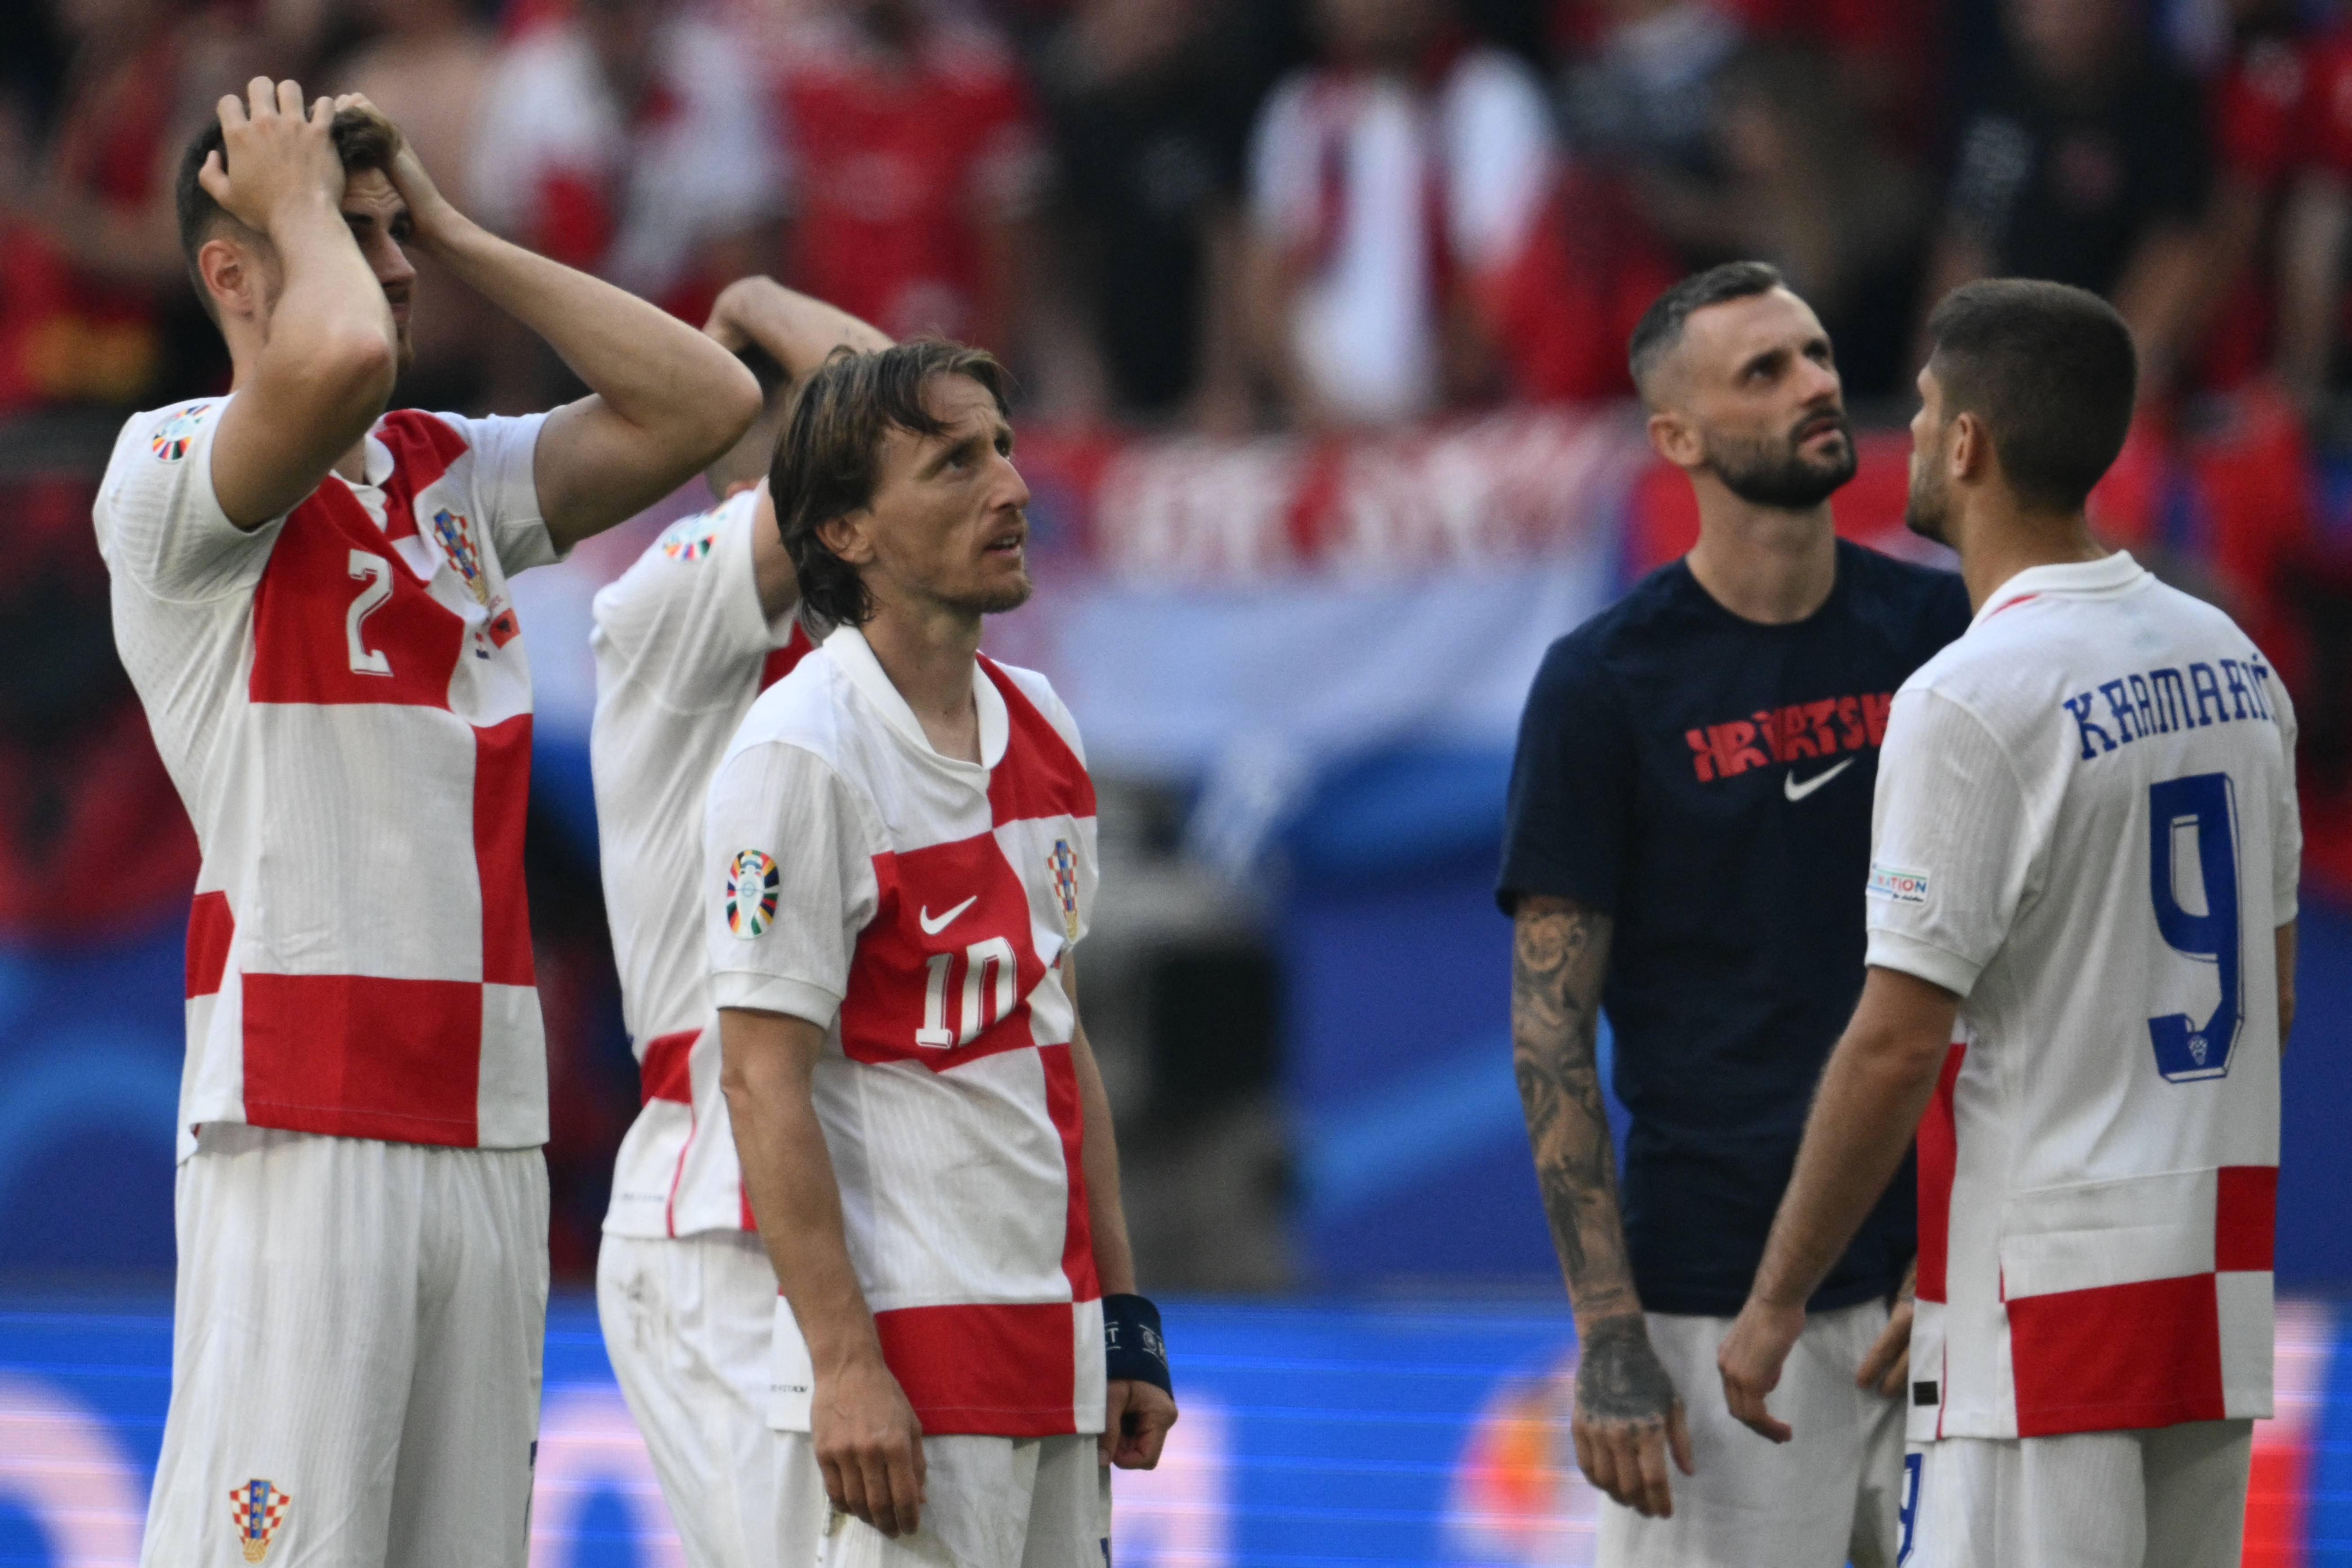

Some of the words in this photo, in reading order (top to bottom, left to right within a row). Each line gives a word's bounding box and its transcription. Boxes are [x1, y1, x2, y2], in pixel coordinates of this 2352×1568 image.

[346, 548, 394, 677] 2
[915, 936, 1017, 1049] 10
[2148, 772, 2245, 1084] 9
